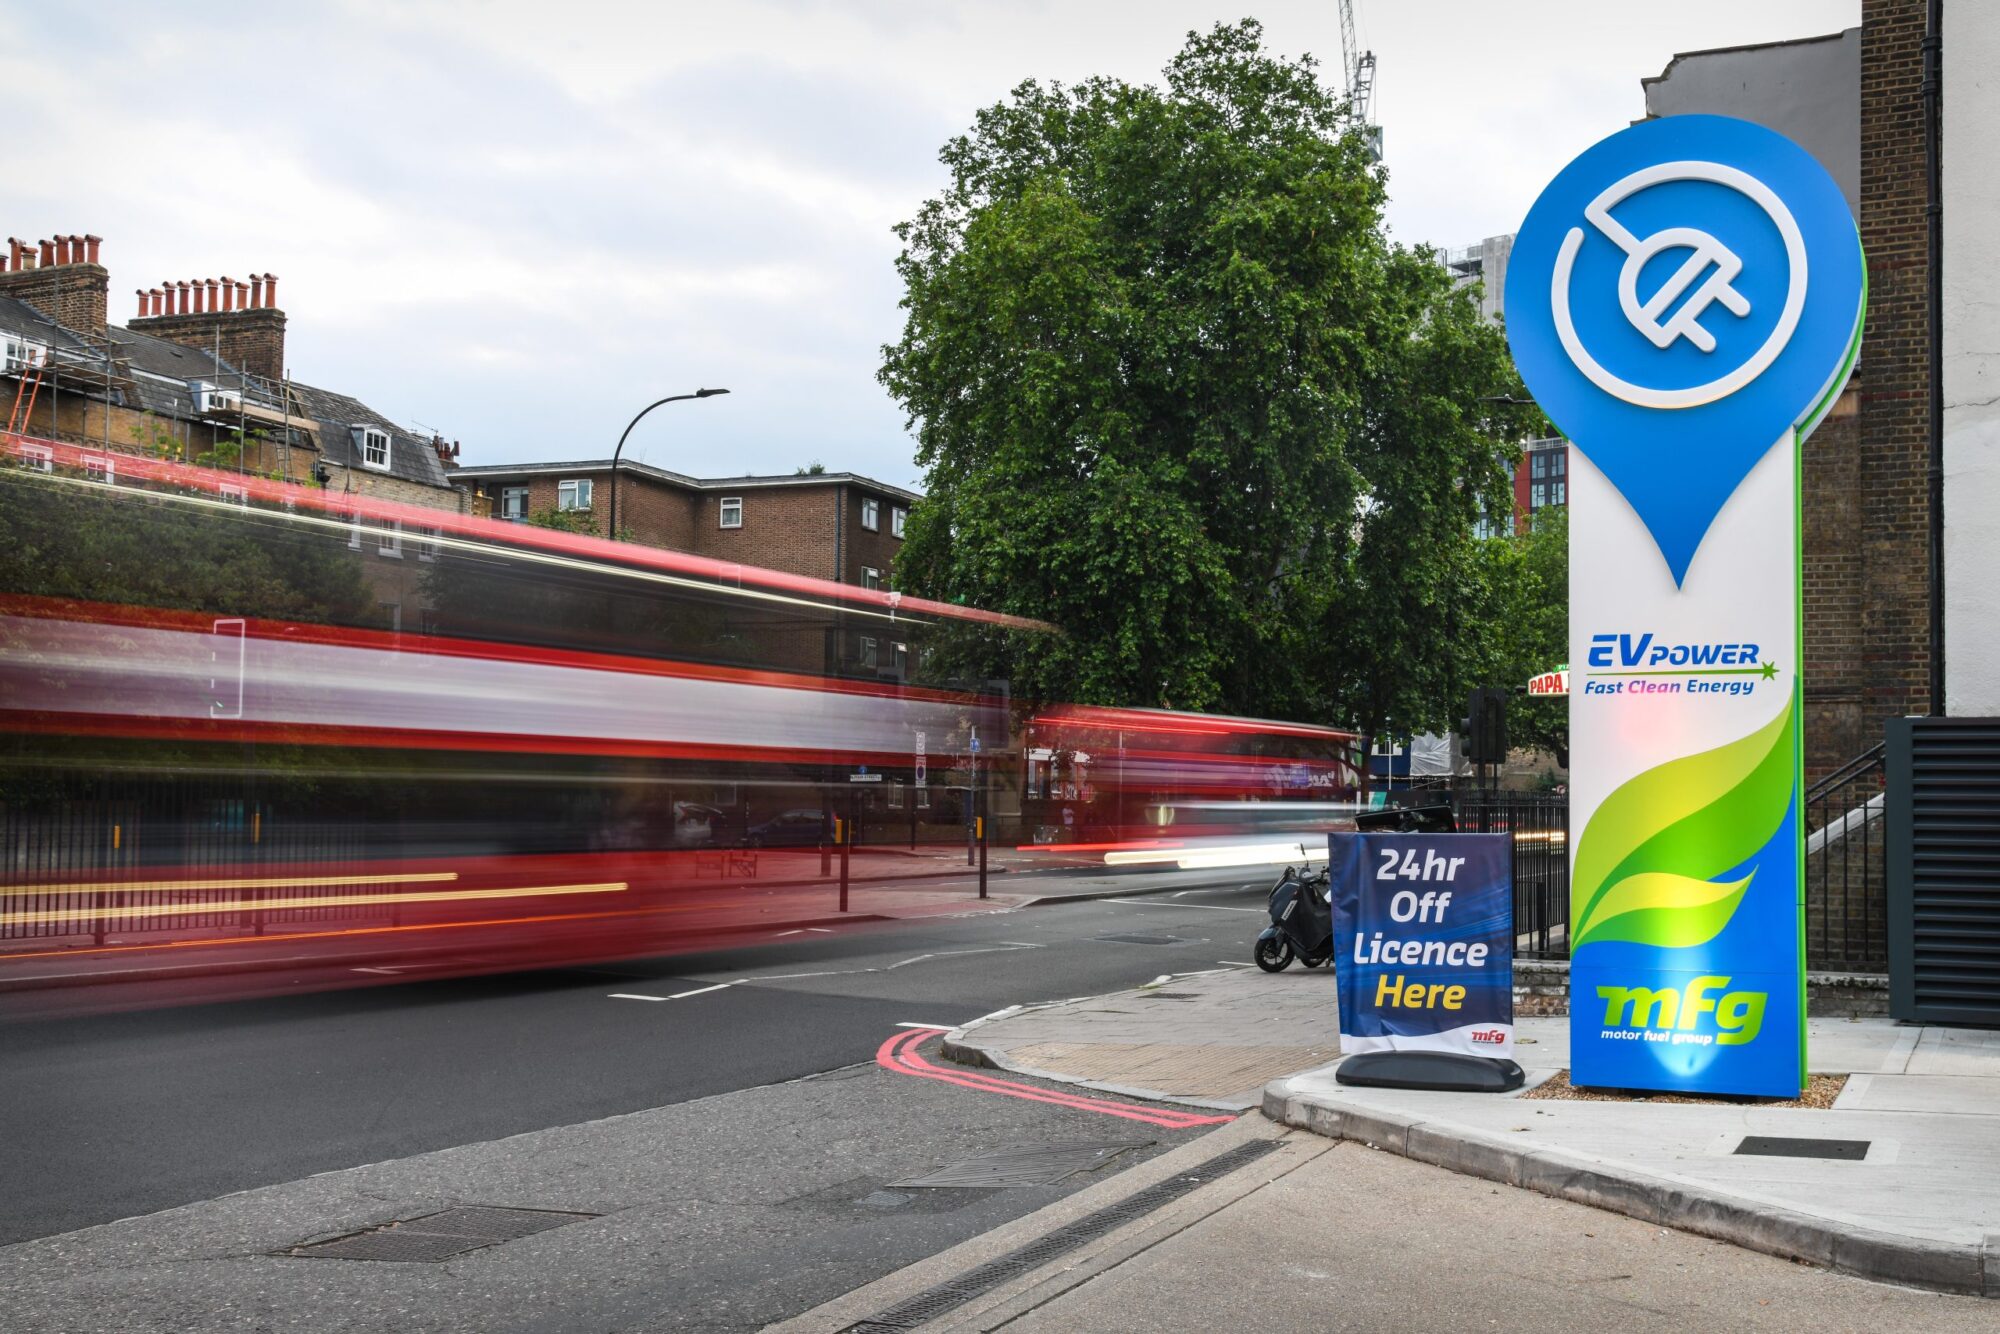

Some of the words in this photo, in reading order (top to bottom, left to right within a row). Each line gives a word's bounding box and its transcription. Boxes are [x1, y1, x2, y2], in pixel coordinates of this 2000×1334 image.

[1530, 673, 1564, 694] PAPA
[1584, 681, 1623, 695] Fast
[1628, 680, 1681, 694] Clean
[1687, 679, 1754, 696] Energy
[1376, 849, 1466, 881] 24hr
[1390, 891, 1452, 923] Off
[1354, 932, 1488, 967] Licence
[1375, 974, 1467, 1010] Here
[1596, 975, 1769, 1046] mfg
[1471, 1029, 1506, 1044] mfg
[1601, 1028, 1642, 1041] motor
[1643, 1030, 1670, 1042] fuel
[1671, 1032, 1713, 1046] group
